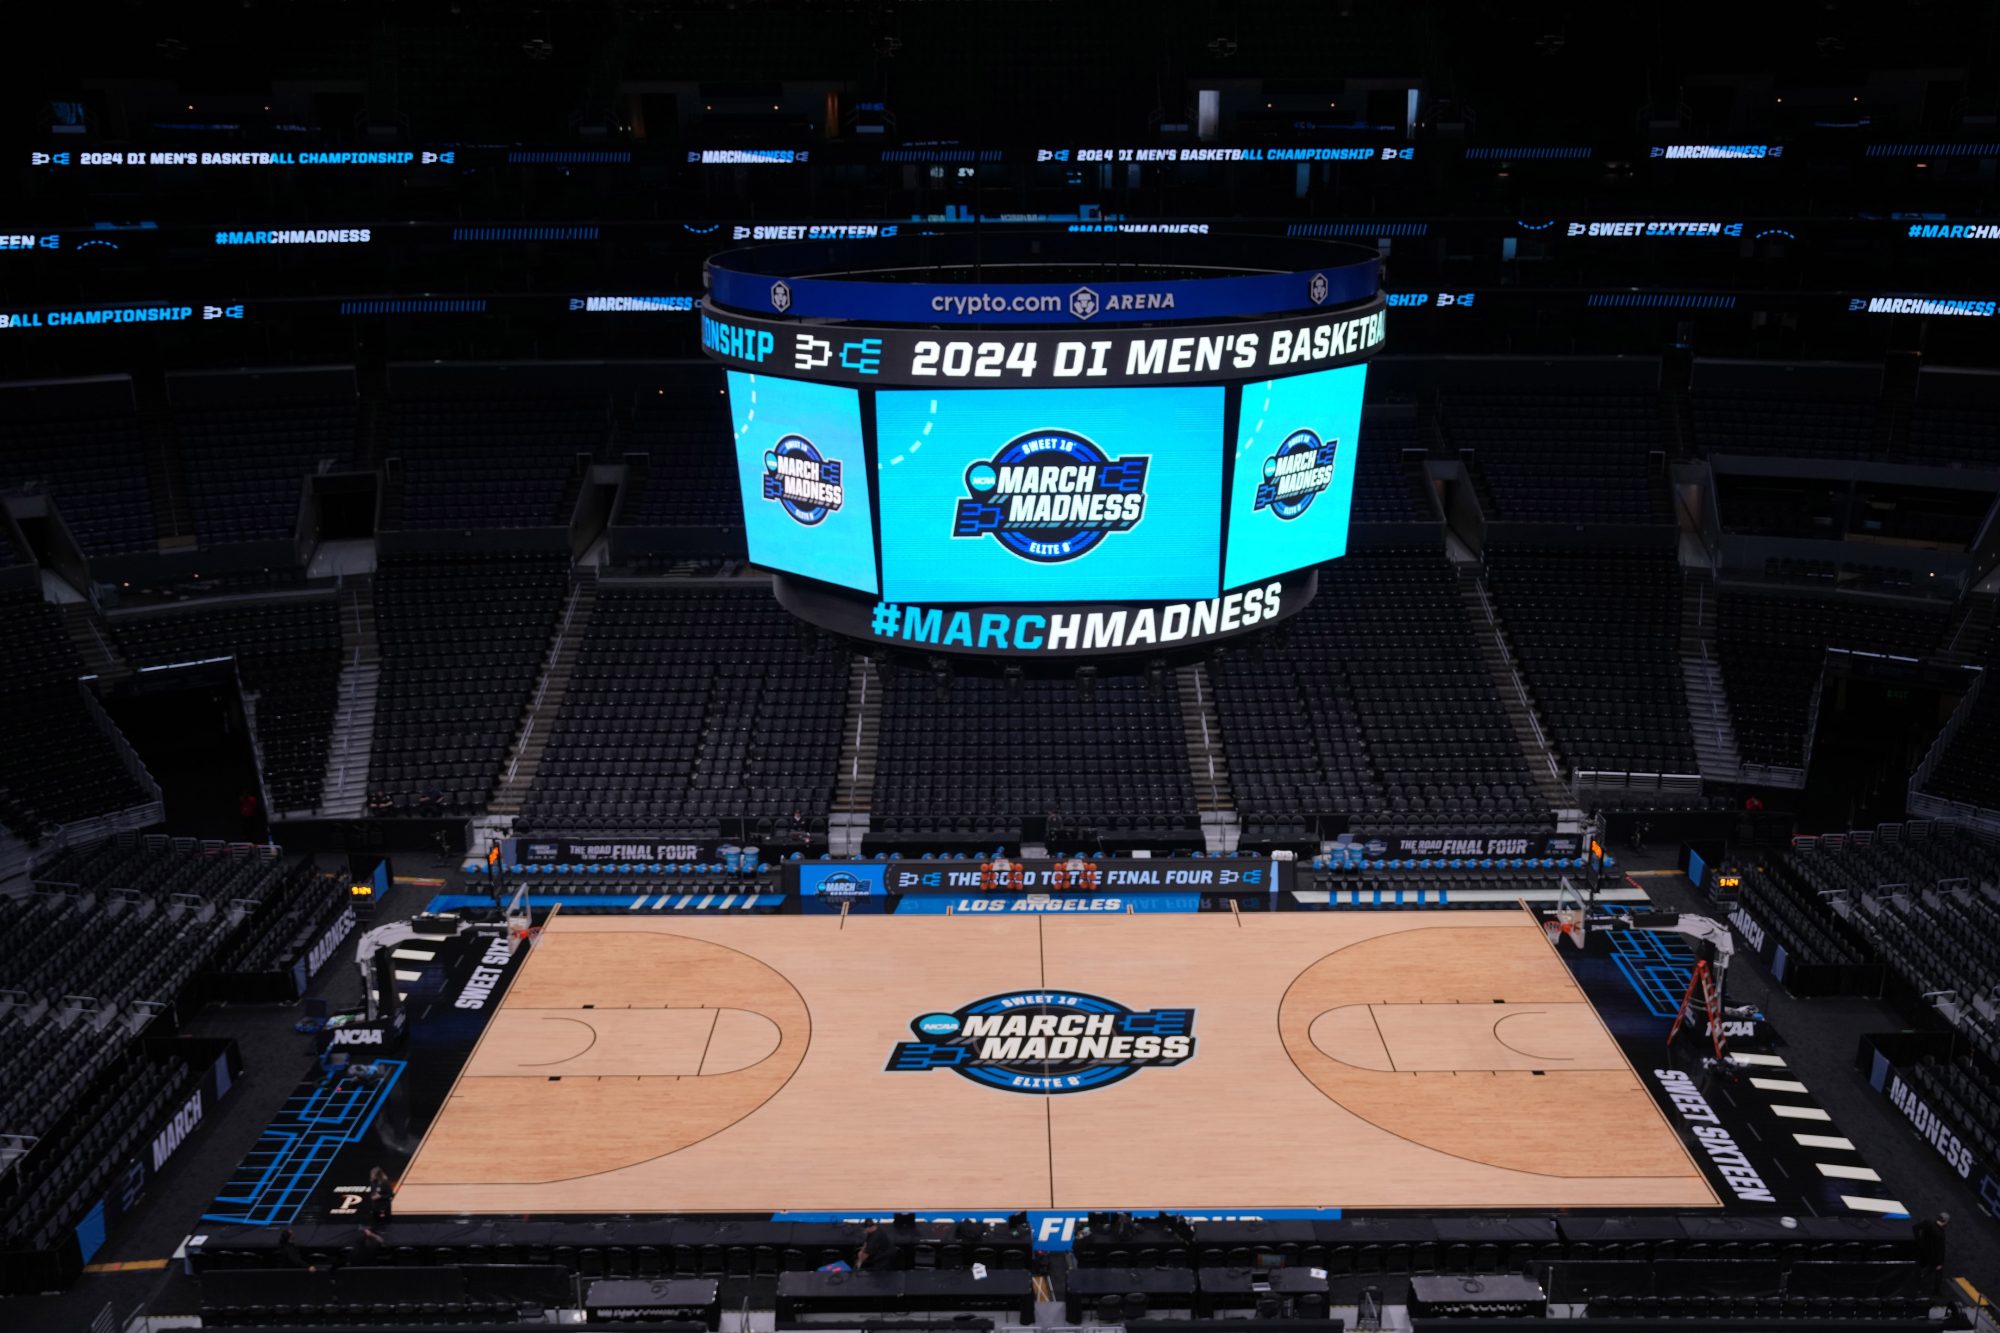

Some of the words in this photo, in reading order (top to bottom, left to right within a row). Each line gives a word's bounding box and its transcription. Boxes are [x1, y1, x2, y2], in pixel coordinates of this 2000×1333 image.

[80, 152, 123, 165] 2024
[127, 152, 146, 165] DI
[150, 152, 197, 165] MEN'S
[201, 152, 295, 165] BASKETBALL
[298, 151, 414, 165] CHAMPIONSHIP
[701, 149, 795, 164] MARCHMADNESS
[1076, 149, 1114, 162] 2024
[1118, 149, 1133, 161] DI
[1135, 148, 1177, 161] MEN'S
[1179, 148, 1264, 161] BASKETBALL
[1266, 148, 1375, 161] CHAMPIONSHIP
[1665, 144, 1768, 159] MARCHMADNESS
[214, 228, 371, 245] #MARCHMADNESS
[753, 225, 806, 240] SWEET
[807, 225, 878, 240] SIXTEEN
[1587, 222, 1645, 237] SWEET
[1645, 222, 1721, 237] SIXTEEN
[586, 295, 694, 312] MARCHMADNESS
[931, 293, 1062, 315] crypto.com
[1105, 293, 1176, 310] ARENA
[1867, 297, 1997, 317] MARCHMADNESS
[48, 307, 193, 327] CHAMPIONSHIP
[911, 340, 1039, 378] 2024
[1052, 340, 1113, 378] DI
[1125, 333, 1259, 376] MEN'S
[1021, 439, 1058, 455] SWEET
[1060, 439, 1073, 452] 16
[777, 455, 820, 481] MARCH
[1274, 449, 1317, 477] MARCH
[996, 465, 1097, 494] MARCH
[1277, 465, 1333, 495] MADNESS
[784, 475, 842, 505] MADNESS
[1008, 493, 1142, 522] MADNESS
[1029, 541, 1060, 555] ELITE
[871, 581, 1283, 651] #MARCHMADNESS
[569, 845, 586, 855] THE
[587, 845, 612, 855] ROAD
[612, 844, 655, 860] FINAL
[657, 844, 697, 860] FOUR
[1400, 839, 1417, 850] THE
[1417, 840, 1442, 850] ROAD
[1442, 839, 1484, 855] FINAL
[1487, 838, 1528, 855] FOUR
[948, 872, 981, 886] THE
[990, 872, 1036, 886] OD
[1070, 872, 1103, 886] TE
[1106, 871, 1160, 885] FINAL
[1165, 870, 1213, 885] FOUR
[957, 899, 1005, 911] LOS
[1010, 898, 1121, 912] ANGELES
[454, 965, 503, 1010] SWEET
[1000, 994, 1055, 1008] SWEET
[922, 1022, 960, 1032] NCAA
[960, 1014, 1115, 1037] MARCH
[332, 1029, 384, 1045] NCAA
[978, 1035, 1191, 1060] MADNESS
[1012, 1076, 1064, 1088] ELITE
[151, 1088, 202, 1174] MARCH
[1653, 1068, 1722, 1125] SWEET
[1691, 1125, 1777, 1203] SIXTEEN
[1889, 1075, 1975, 1180] MADNESS
